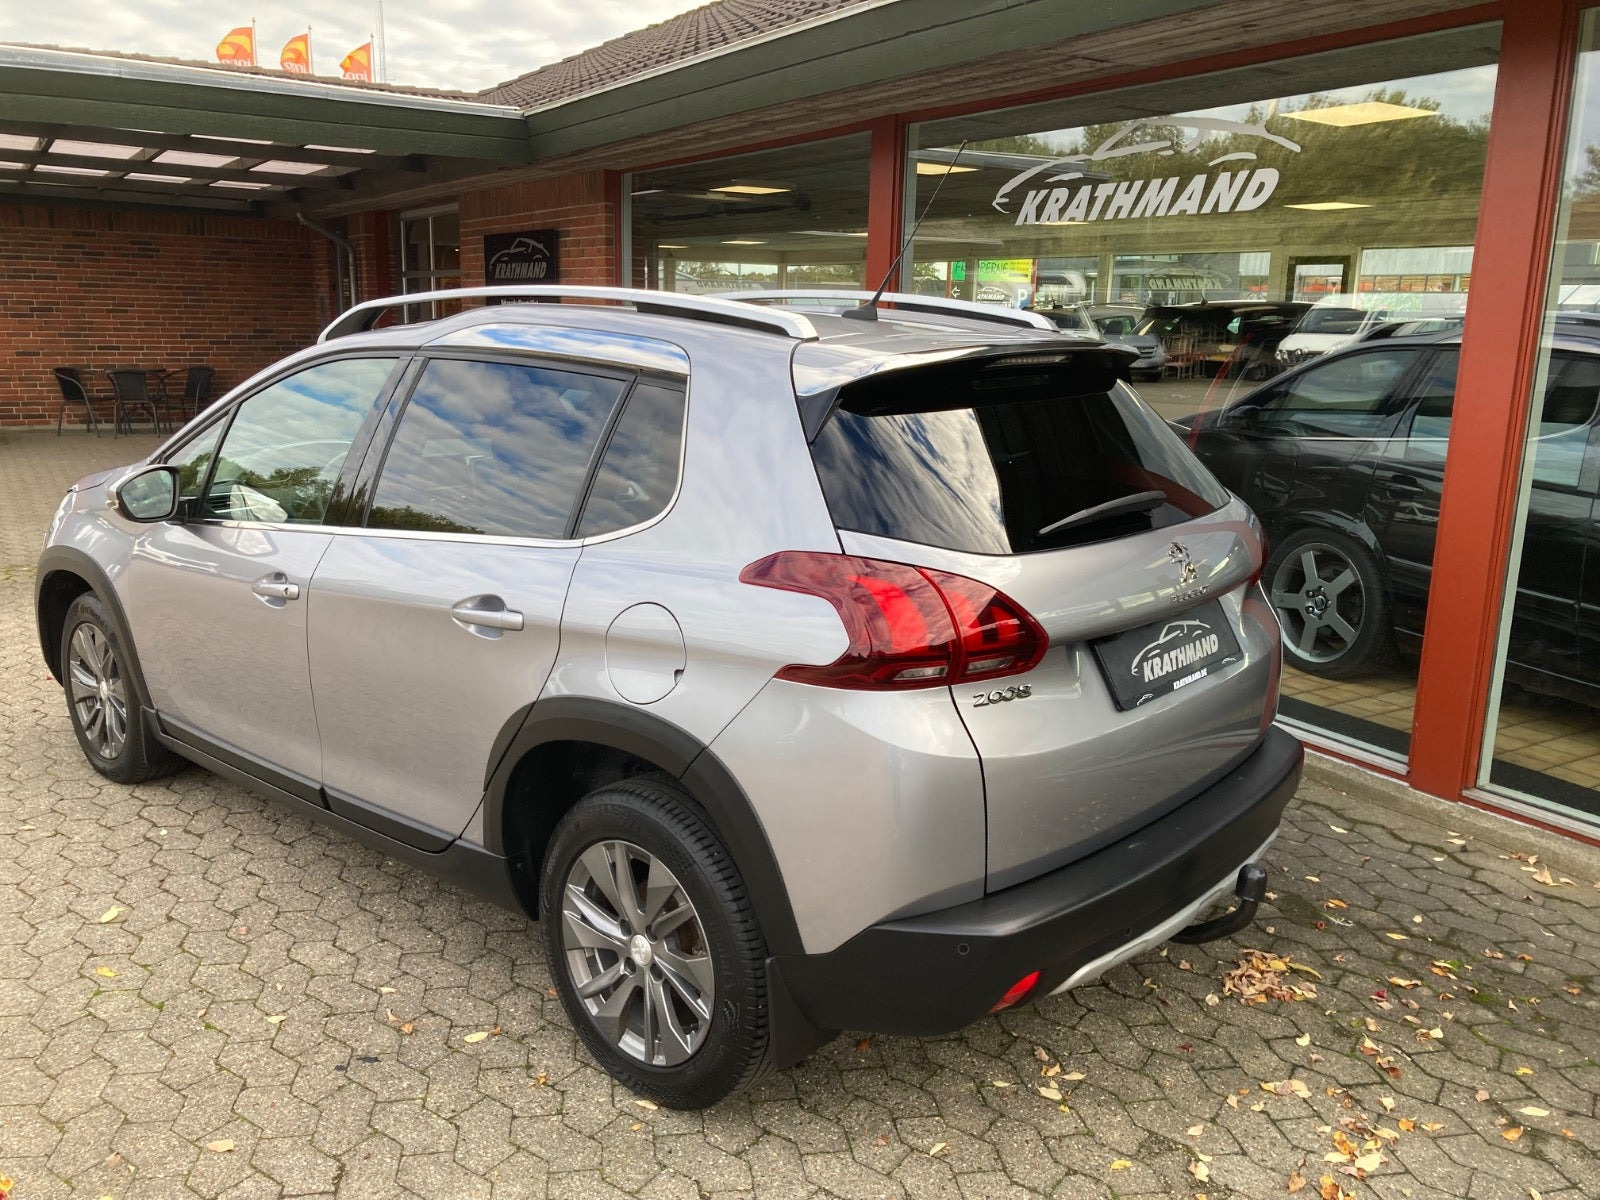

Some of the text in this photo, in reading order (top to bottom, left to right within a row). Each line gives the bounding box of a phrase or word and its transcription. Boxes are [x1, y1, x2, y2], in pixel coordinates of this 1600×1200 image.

[1015, 167, 1280, 226] KRATHMAND
[494, 261, 547, 279] KRATHMAND
[1143, 633, 1219, 683] KRATHMAND
[972, 684, 1032, 708] 2008
